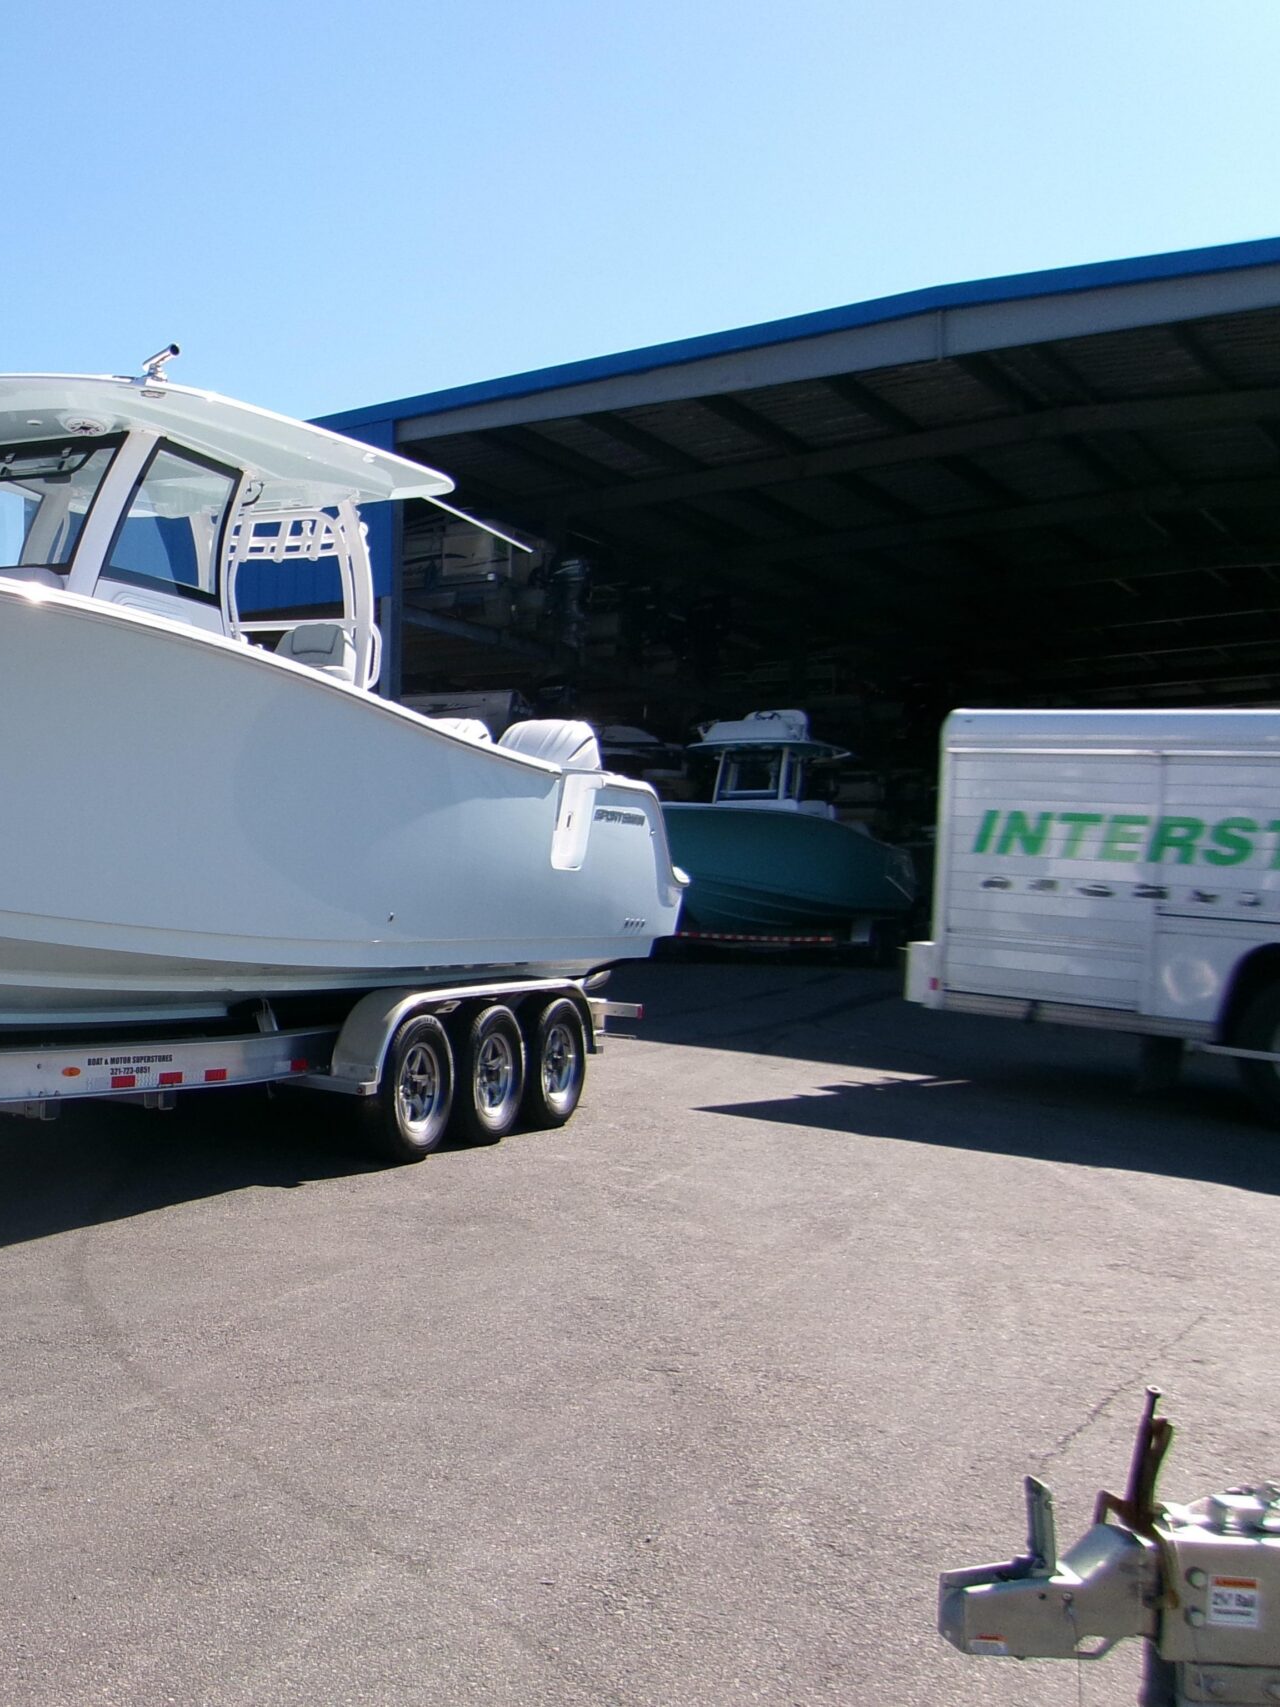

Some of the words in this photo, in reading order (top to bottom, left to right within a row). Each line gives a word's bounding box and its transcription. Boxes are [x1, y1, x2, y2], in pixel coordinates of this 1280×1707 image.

[973, 809, 1280, 870] INTERS
[87, 1058, 103, 1066] BOAT
[110, 1056, 131, 1065] MOTOR
[132, 1054, 173, 1064] SUPERSTORES
